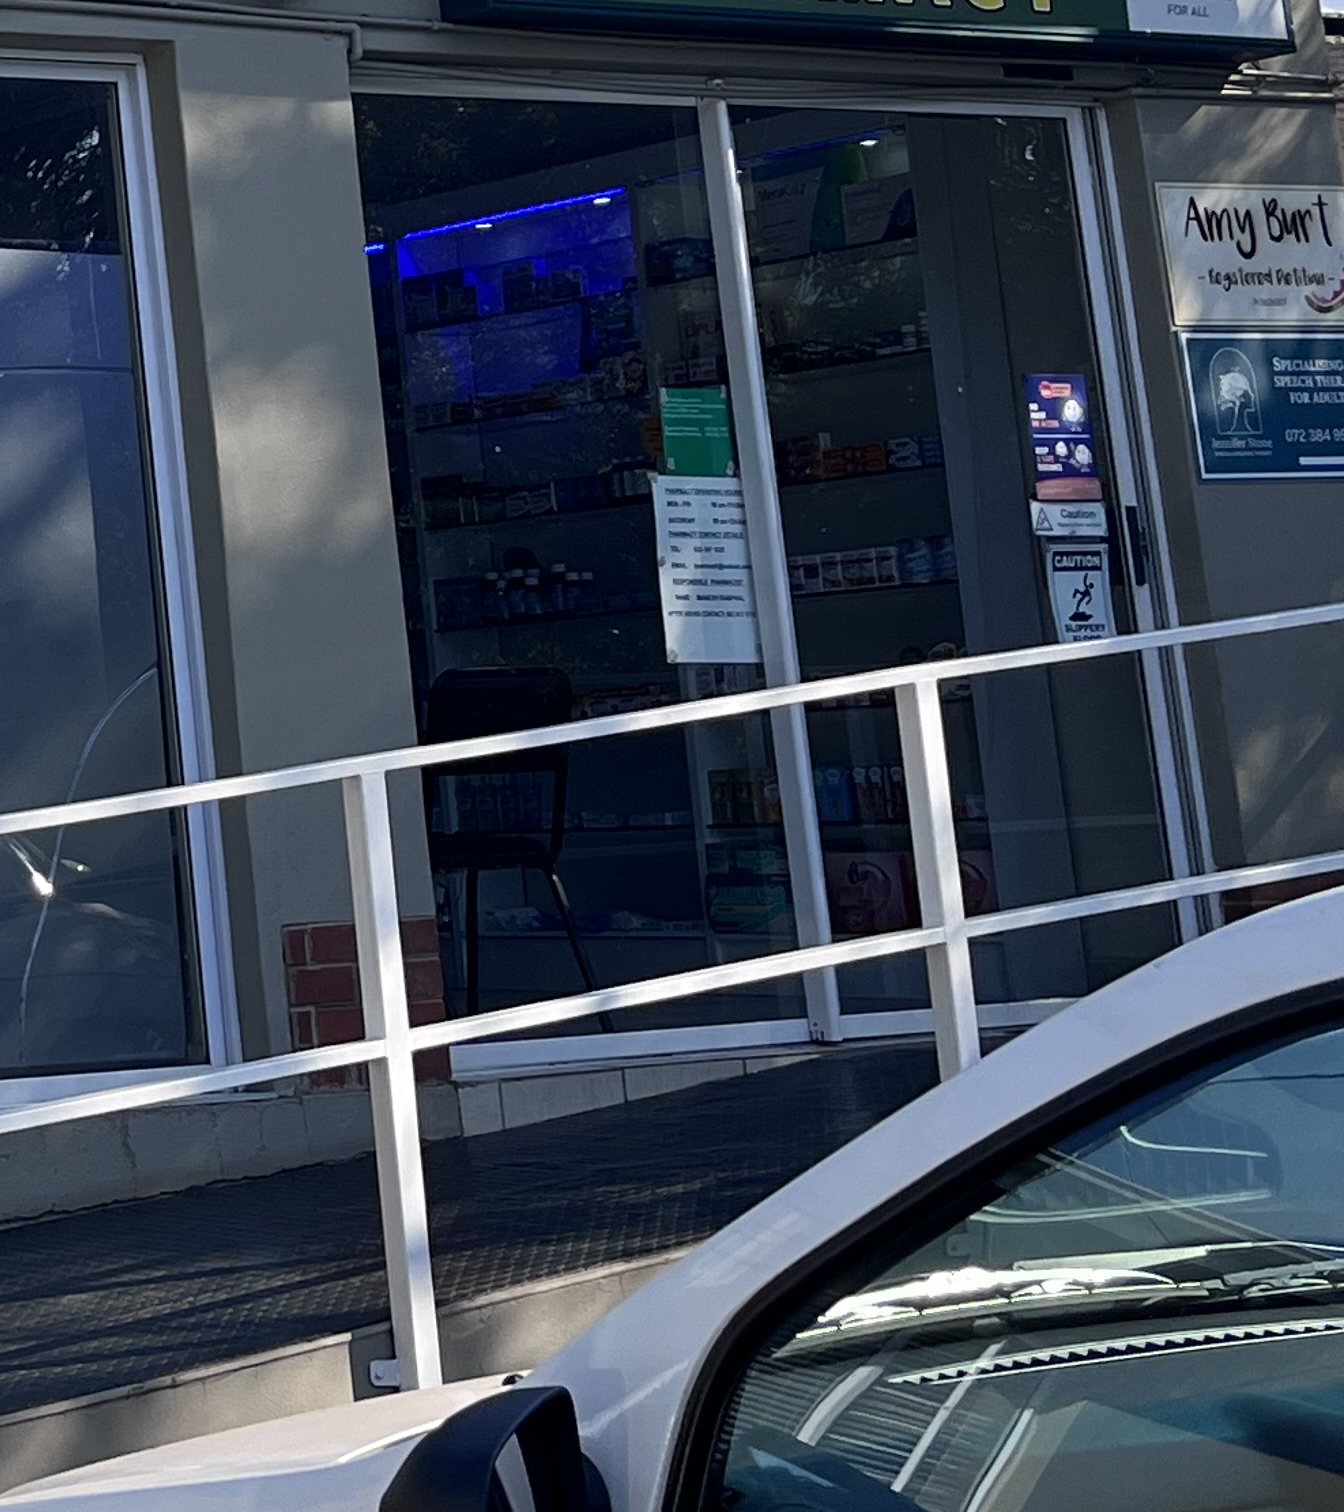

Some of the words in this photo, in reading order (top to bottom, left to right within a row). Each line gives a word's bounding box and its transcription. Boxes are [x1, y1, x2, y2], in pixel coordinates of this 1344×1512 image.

[1167, 3, 1188, 16] FOR
[1191, 5, 1210, 18] ALL
[1184, 196, 1257, 259] Amy
[1263, 193, 1333, 247] Burt
[1314, 375, 1344, 388] THER
[1289, 391, 1311, 404] FOR
[1060, 508, 1097, 519] Caution
[1054, 554, 1100, 568] CAUTION
[1064, 623, 1106, 633] SLIPPERY
